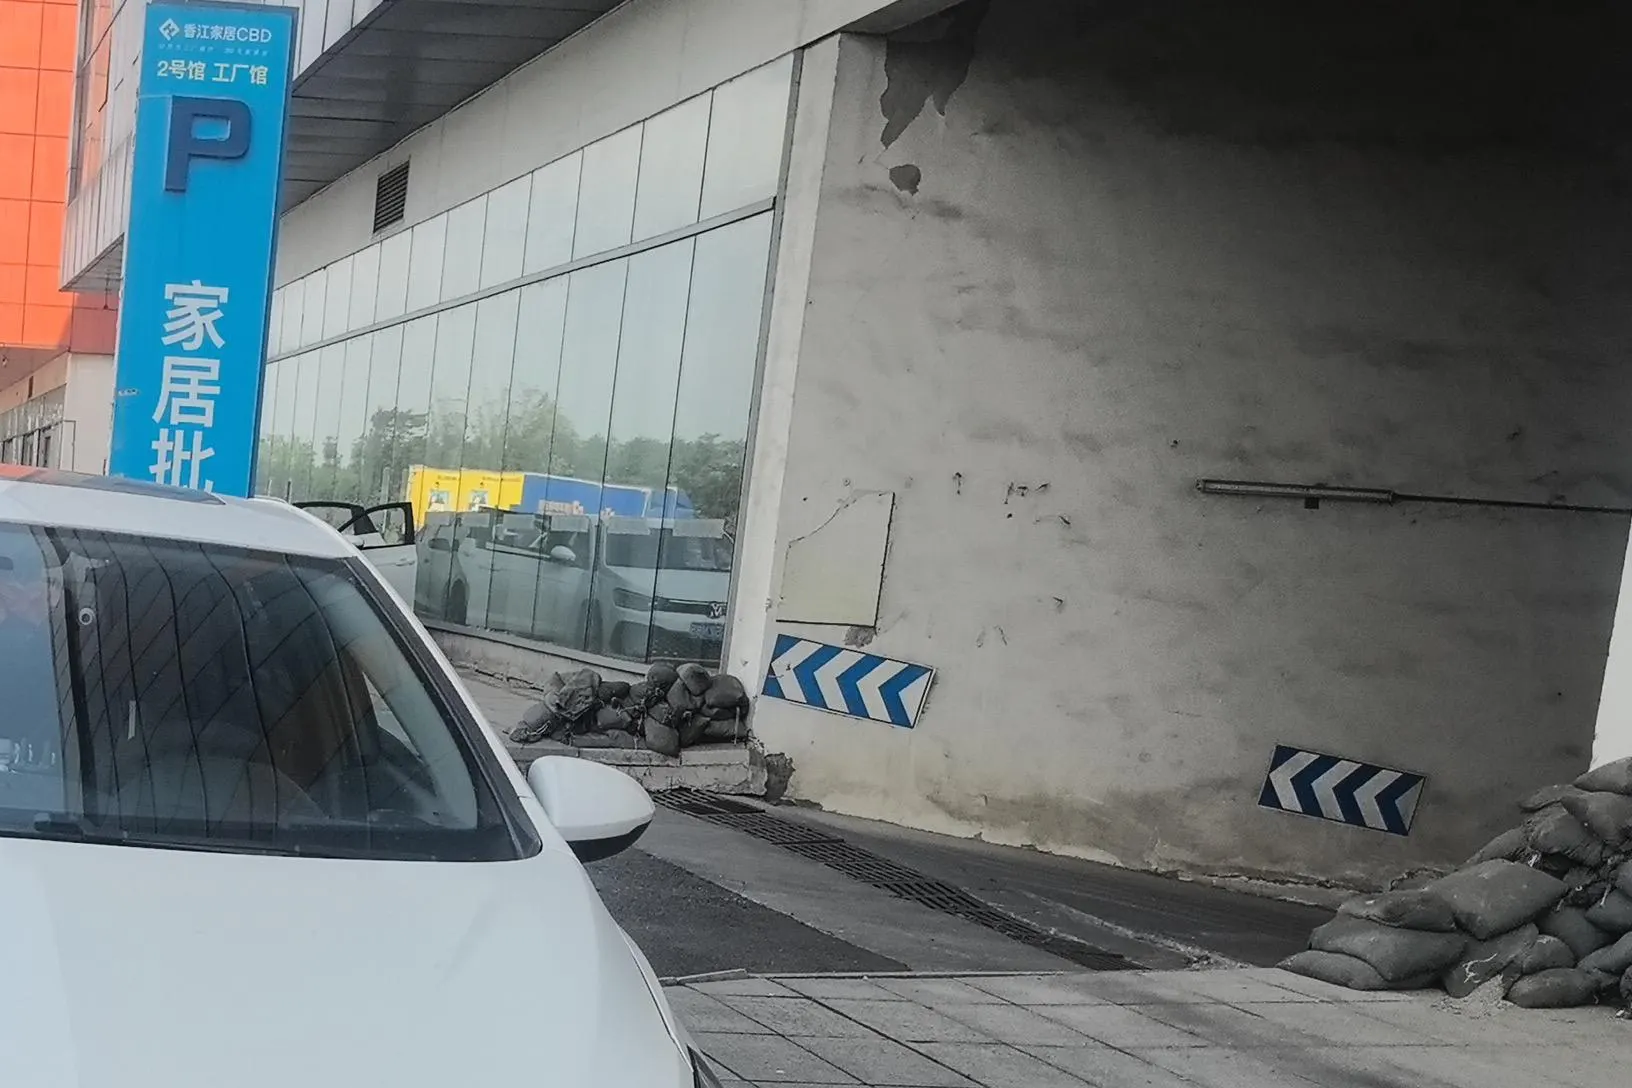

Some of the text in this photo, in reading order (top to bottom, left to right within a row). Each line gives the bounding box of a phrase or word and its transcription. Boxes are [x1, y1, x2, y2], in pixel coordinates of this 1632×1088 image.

[157, 59, 268, 84] 2号馆 工厂馆
[165, 95, 251, 193] P
[148, 279, 229, 493] 家居批
